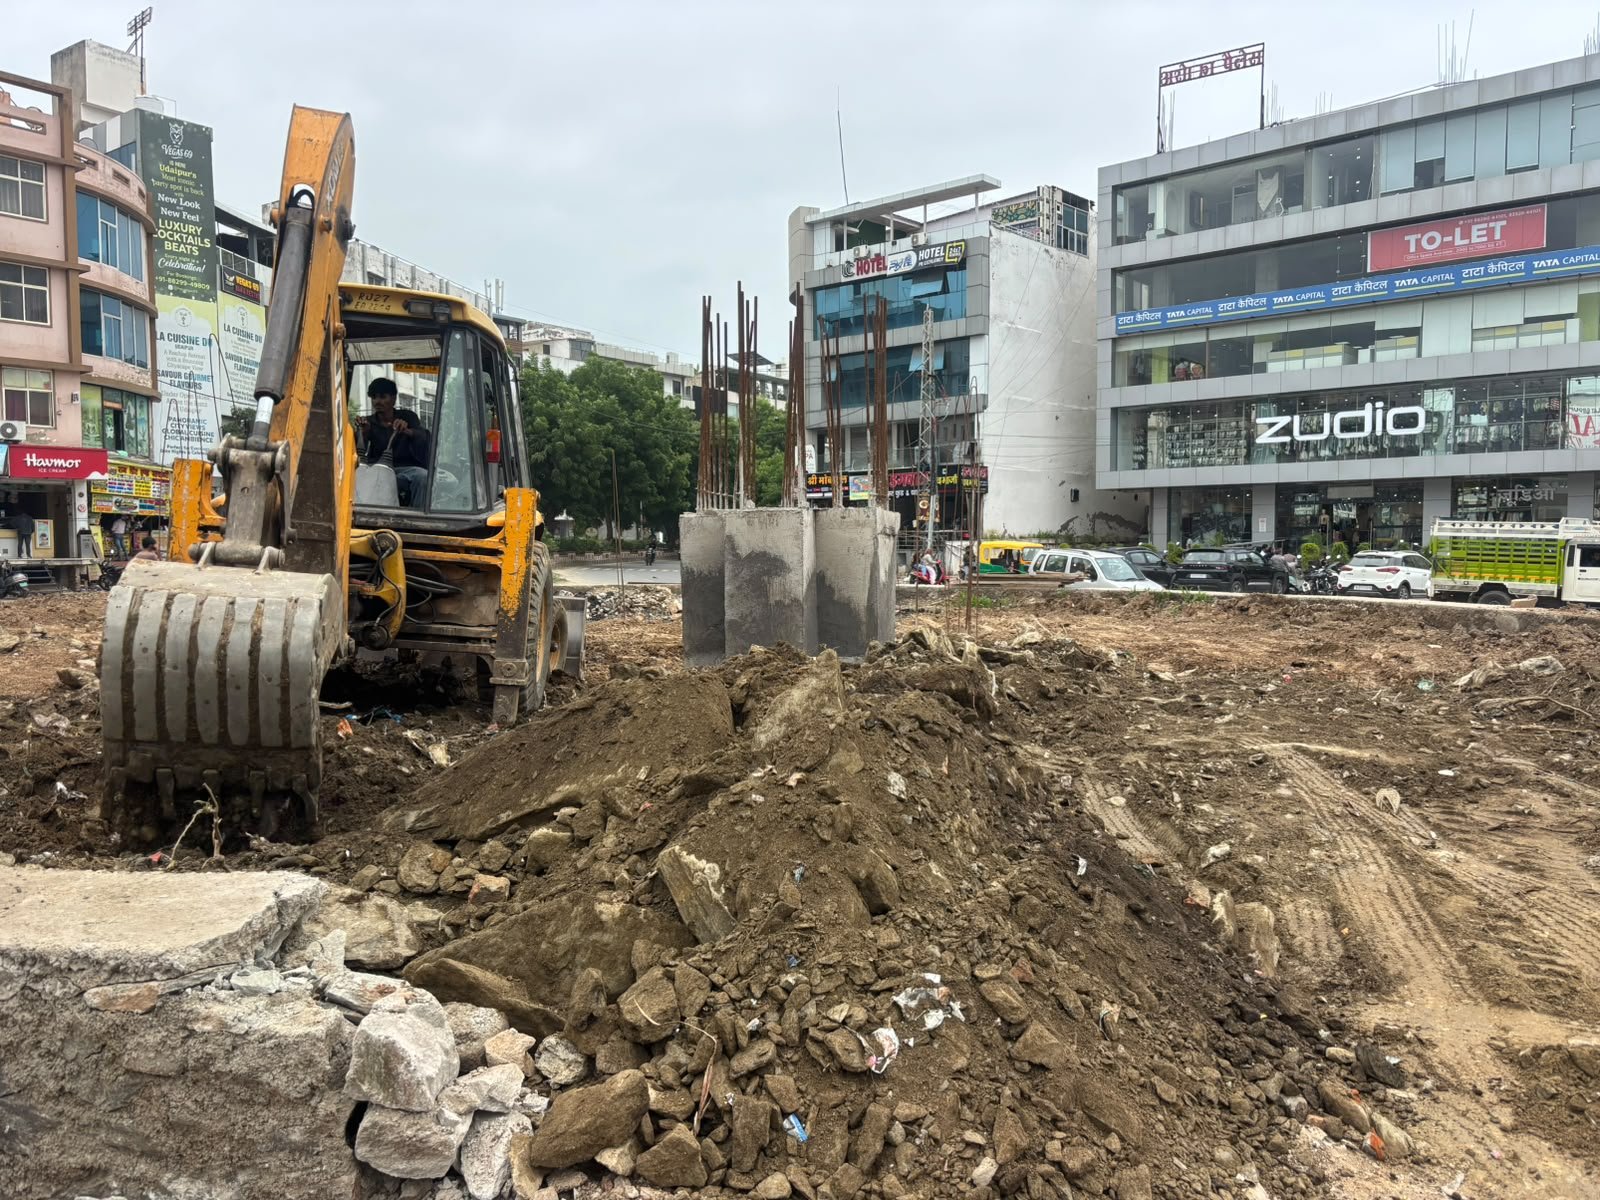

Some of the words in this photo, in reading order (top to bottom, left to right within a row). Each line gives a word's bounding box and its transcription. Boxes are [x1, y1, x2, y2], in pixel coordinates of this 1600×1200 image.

[159, 163, 197, 179] Udaipur's
[157, 193, 177, 204] New
[180, 198, 201, 209] Look
[160, 206, 180, 218] New
[182, 210, 200, 222] Feel
[158, 218, 203, 236] LUXURY
[153, 229, 211, 248] OCKTAILS
[1404, 220, 1507, 253] TO-LET
[164, 240, 199, 256] BEATS
[918, 245, 945, 261] HOTEL
[157, 258, 206, 273] Celebration!
[855, 255, 888, 276] HOTEL
[1461, 266, 1484, 278] टाटा
[1487, 259, 1525, 275] कैपिटल
[1532, 258, 1560, 268] TATA
[1562, 253, 1600, 265] CAPITAL
[1331, 284, 1352, 296] टाटा
[1354, 276, 1388, 292] कैपिटल
[1394, 277, 1418, 287] TATA
[1420, 272, 1455, 283] CAPITAL
[1217, 301, 1236, 312] टाटा
[1237, 297, 1267, 309] कैपिटल
[1272, 295, 1294, 304] TATA
[1295, 290, 1326, 301] CAPITAL
[1118, 315, 1134, 325] टाटा
[1135, 311, 1162, 322] कैपिटल
[1166, 310, 1185, 318] TATA
[1186, 306, 1213, 316] CAPITAL
[167, 332, 200, 346] CUISINE
[223, 323, 231, 334] LA
[232, 326, 254, 341] CUISINE
[157, 369, 182, 380] SAVOUR
[183, 372, 212, 382] GOURME
[169, 379, 203, 390] FLAVOURS
[1255, 401, 1426, 444] zudio
[23, 453, 81, 468] Havmor
